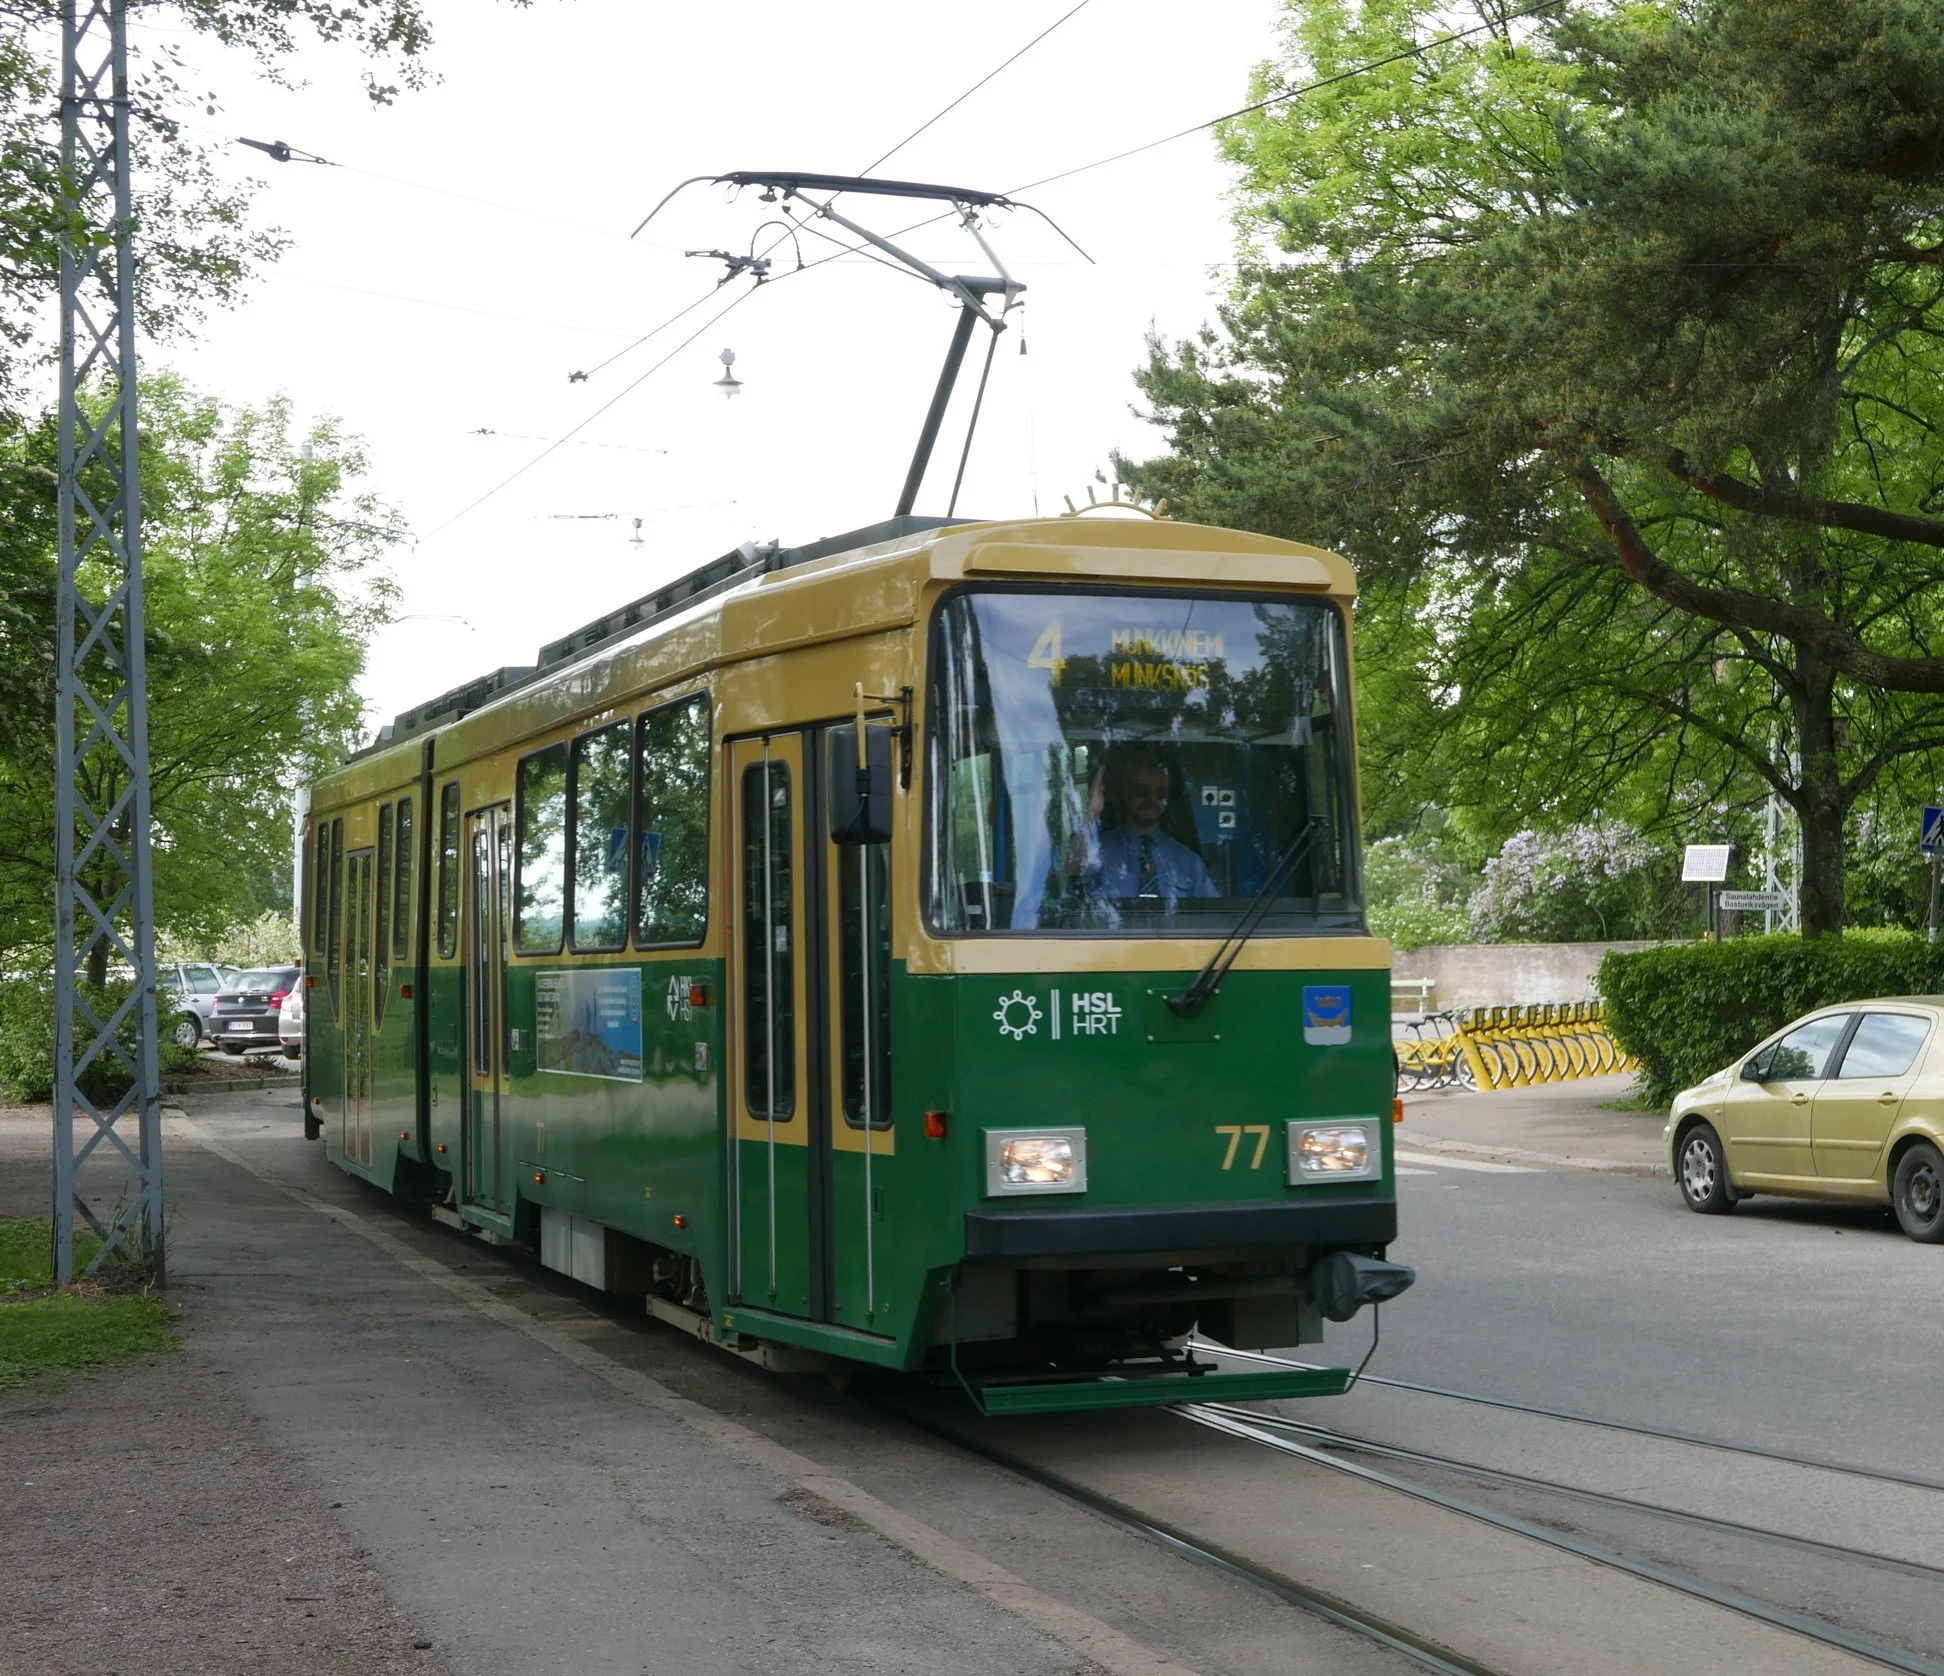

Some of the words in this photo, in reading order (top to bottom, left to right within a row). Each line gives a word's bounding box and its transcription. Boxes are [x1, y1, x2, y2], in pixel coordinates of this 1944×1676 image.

[1027, 619, 1067, 687] 4
[1724, 900, 1779, 909] Bastuviksvägen
[1725, 892, 1779, 901] Saunalahdentie
[1072, 992, 1122, 1013] HSL
[1073, 1014, 1122, 1035] HRT
[1215, 1125, 1270, 1170] 77
